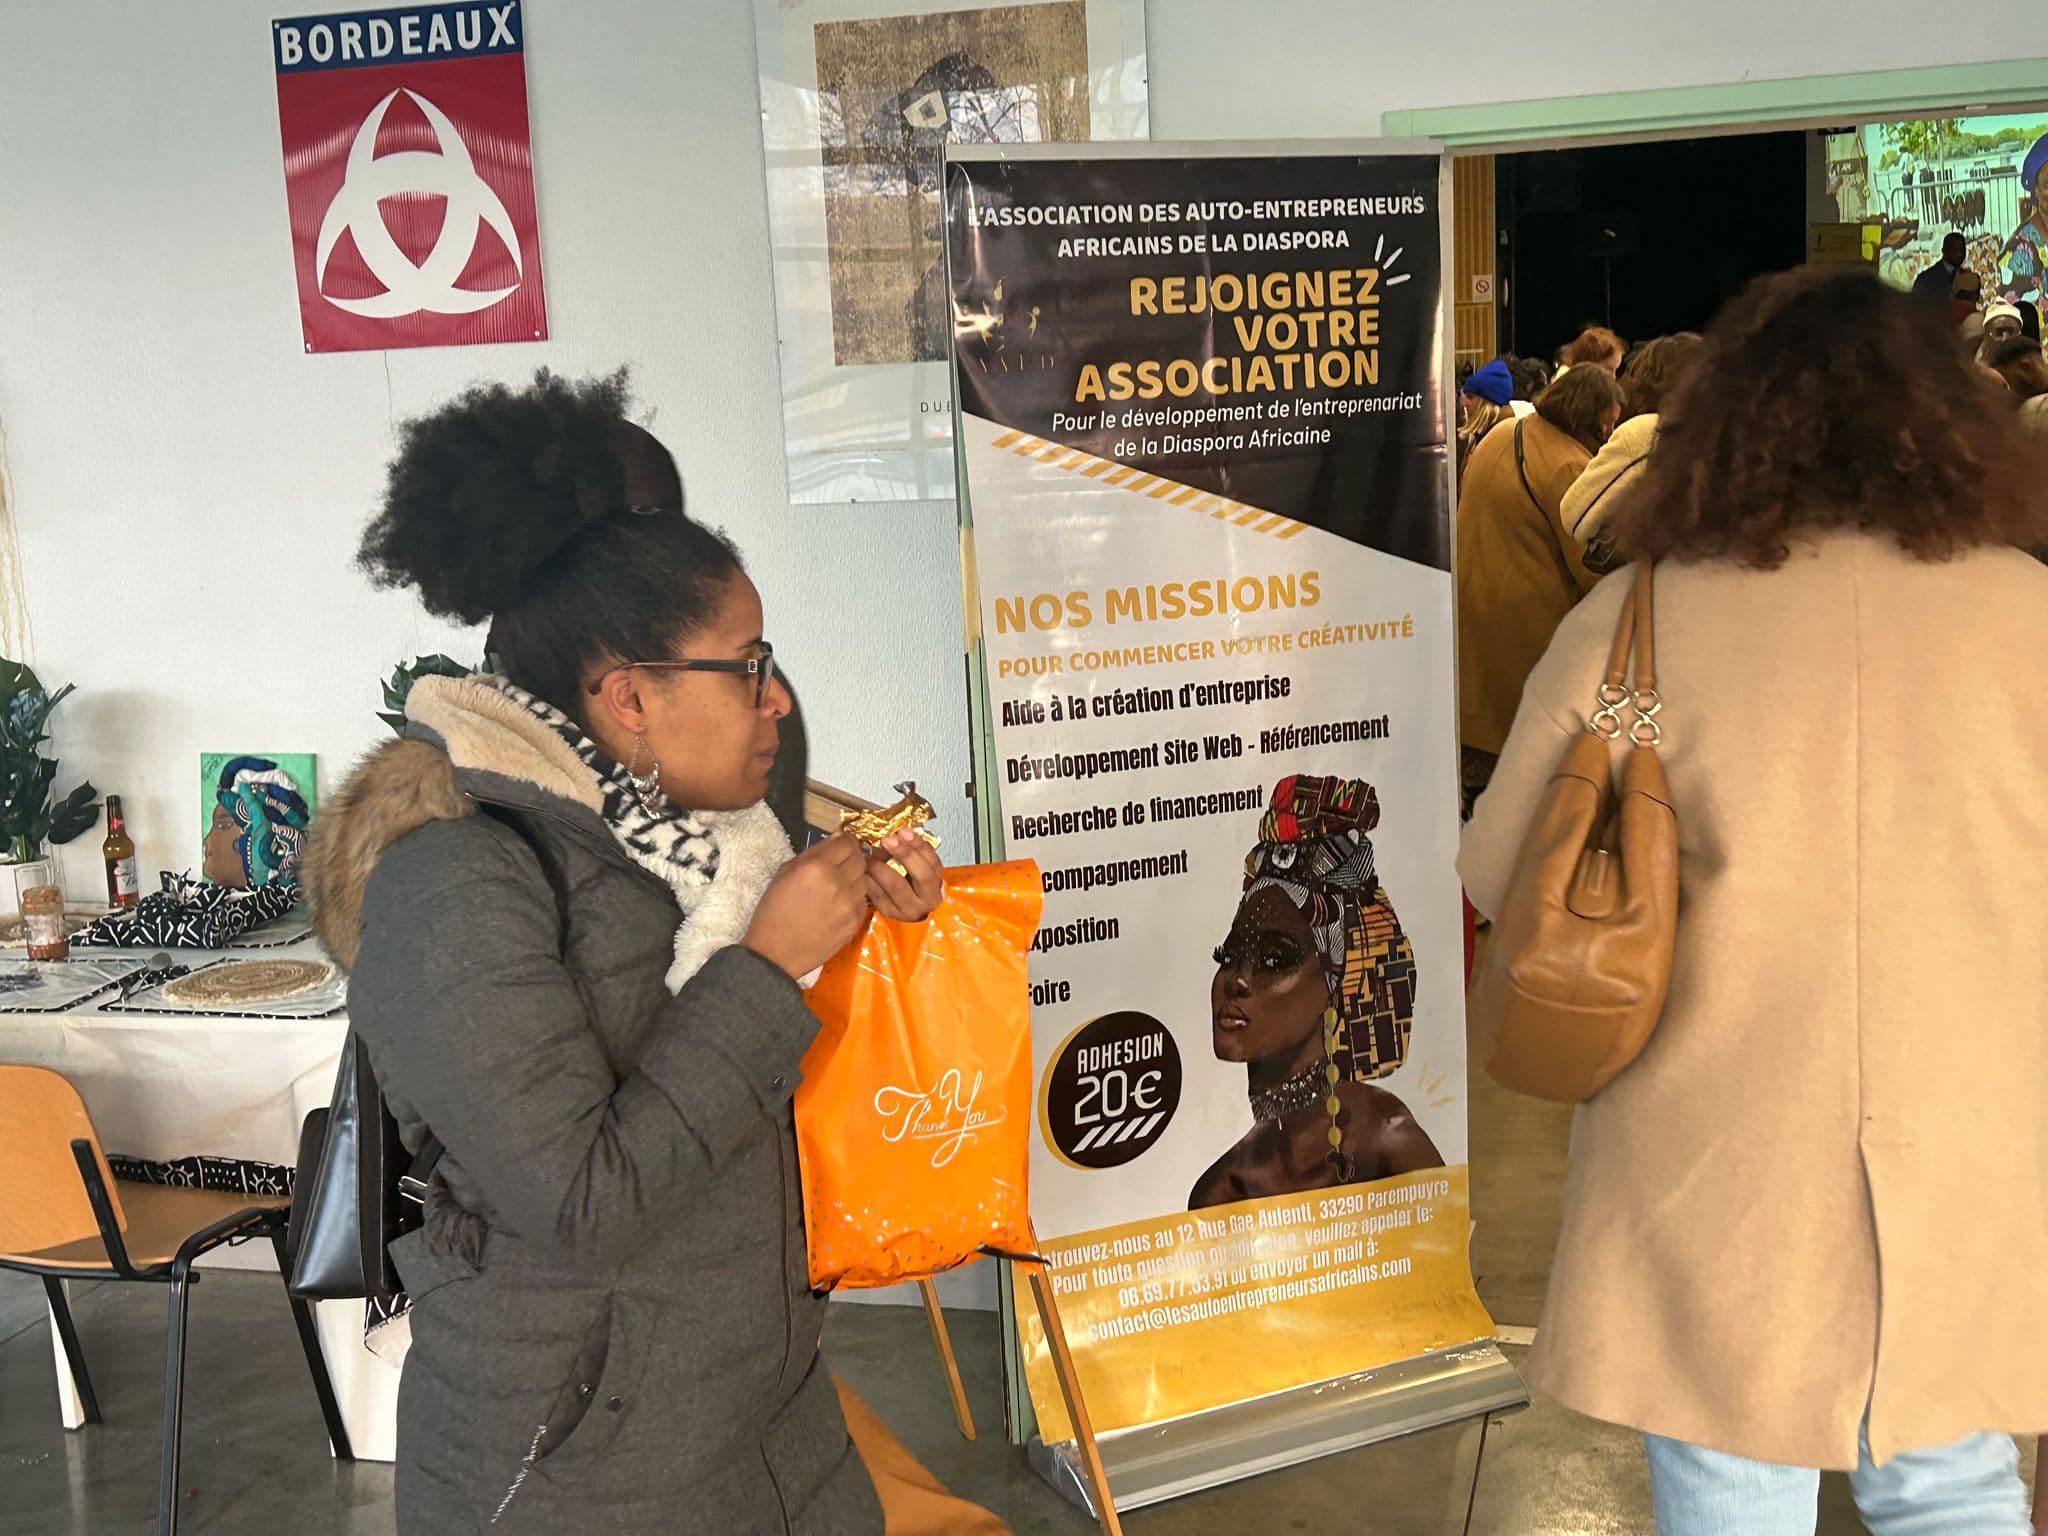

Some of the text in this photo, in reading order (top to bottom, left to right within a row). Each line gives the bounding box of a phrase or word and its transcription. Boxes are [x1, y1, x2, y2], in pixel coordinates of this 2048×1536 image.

[279, 5, 516, 66] BORDEAUX
[968, 195, 1425, 227] L'ASSOCIATION DES AUTO-ENTREPRENEURS
[1057, 229, 1350, 258] AFRICAINS DE LA DIASPORA
[1130, 268, 1380, 316] REJOIGNEZ
[1233, 309, 1380, 352] VOTRE
[1075, 349, 1379, 402] ASSOCIATION
[1052, 392, 1422, 433] Pour le développement de l'entreprenariat
[1113, 427, 1331, 458] de la Diaspora Africaine
[995, 571, 1321, 634] NOS MISSIONS
[998, 614, 1414, 679] POUR COMMENCER VOTRE CRÉATIVITÉ
[1002, 673, 1291, 727] Aide à la création d'entreprise
[1007, 743, 1159, 784] Développement
[1164, 737, 1199, 765] Site
[1203, 733, 1243, 762] Web
[1260, 714, 1390, 755] Référencement
[1011, 784, 1263, 841] Recherche de financement
[1041, 849, 1188, 892] compagnement
[1027, 917, 1120, 953] xposition
[1077, 1032, 1163, 1075] ADHESION
[931, 1068, 987, 1167] You
[1074, 1070, 1162, 1126] 20€
[1042, 1234, 1150, 1272] etrouvez-nous
[1155, 1230, 1174, 1248] au
[1177, 1224, 1195, 1242] 12
[1198, 1219, 1226, 1240] Rue
[1319, 1195, 1363, 1220] 33290
[1368, 1180, 1448, 1210] Parempuyre
[1052, 1273, 1088, 1296] Pour
[1093, 1262, 1132, 1287] toute
[1305, 1220, 1357, 1246] veuillez
[1361, 1209, 1412, 1235] appeler
[1417, 1205, 1434, 1223] le:
[1231, 1265, 1247, 1285] ou
[1251, 1254, 1308, 1280] envoyer
[1313, 1250, 1330, 1269] un
[1334, 1240, 1363, 1264] mail
[1367, 1237, 1379, 1257] à:
